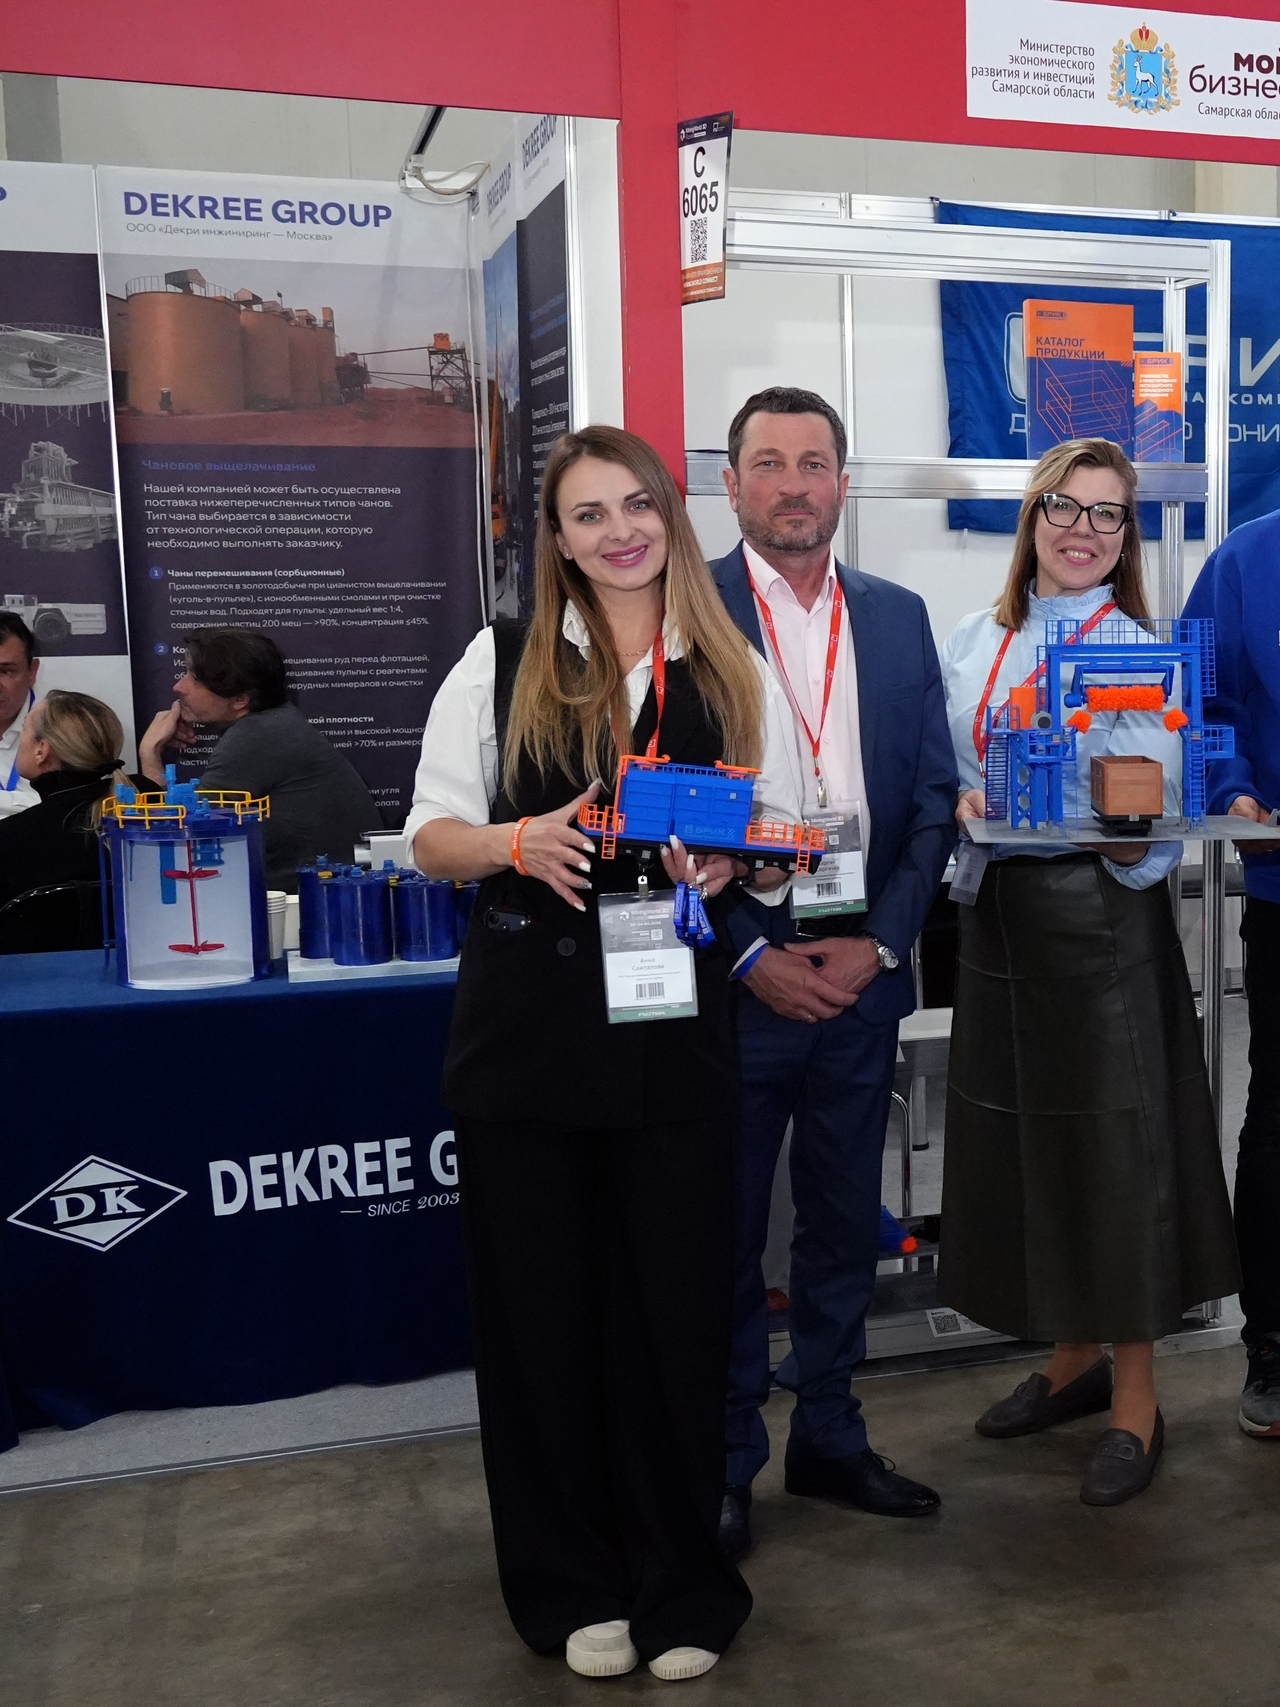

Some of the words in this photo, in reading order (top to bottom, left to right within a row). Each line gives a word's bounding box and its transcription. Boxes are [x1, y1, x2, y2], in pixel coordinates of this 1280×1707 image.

[1020, 38, 1095, 57] Министерство
[1008, 54, 1095, 71] экономического
[971, 65, 1020, 79] развития
[1023, 71, 1030, 79] и
[1033, 71, 1095, 86] инвестиций
[992, 79, 1050, 97] Самарской
[1053, 85, 1095, 99] области
[1198, 102, 1252, 119] Самарская
[682, 180, 719, 219] 6065
[123, 191, 263, 222] DEKREE
[271, 200, 392, 228] GROUP
[158, 224, 200, 237] «Декри
[202, 229, 271, 240] инжиниринг
[286, 231, 333, 242] Москва»
[1036, 336, 1085, 347] КАТАЛОГ
[1036, 348, 1105, 360] ПРОДУКЦИИ
[142, 460, 202, 471] Чановое
[206, 461, 316, 472] выщелачивание
[143, 483, 185, 493] Нашей
[186, 484, 251, 494] компанией
[253, 486, 290, 494] может
[291, 485, 319, 495] быть
[320, 486, 401, 496] осуществлена
[144, 499, 198, 507] поставка
[200, 499, 321, 509] нижеперечисленных
[323, 500, 356, 508] типов
[357, 500, 393, 508] чанов.
[145, 511, 167, 521] Тип
[169, 512, 197, 521] чана
[199, 511, 267, 523] выбирается
[269, 513, 277, 521] в
[278, 512, 351, 521] зависимости
[146, 526, 160, 535] от
[161, 525, 263, 535] технологической
[265, 526, 324, 536] операции,
[325, 526, 373, 537] которую
[147, 538, 220, 549] необходимо
[222, 539, 284, 549] выполнять
[285, 539, 343, 550] заказчику.
[153, 569, 160, 577] 1
[167, 569, 194, 578] Чаны
[195, 569, 273, 579] перемешивания
[274, 568, 345, 578] (сорбционные)
[168, 582, 234, 591] Применяются
[242, 582, 307, 590] золотодобыче
[327, 582, 375, 590] цианистом
[376, 581, 447, 589] выщелачивании
[264, 594, 340, 602] ионообменными
[341, 594, 380, 602] смолами
[389, 594, 406, 602] при
[407, 593, 442, 601] очистке
[230, 607, 274, 616] Подходят
[292, 607, 327, 615] пульпы:
[328, 606, 371, 615] удельный
[170, 621, 228, 630] содержание
[262, 619, 280, 627] 200
[341, 619, 405, 627] концентрация
[158, 645, 165, 653] 2
[334, 656, 350, 664] руд
[380, 654, 430, 663] флотацией,
[336, 668, 368, 677] пульпы
[376, 668, 430, 676] реагентами.
[331, 680, 381, 688] минералов
[326, 716, 374, 724] плотности
[355, 727, 391, 735] высокой
[385, 740, 422, 748] размеро
[381, 788, 400, 796] угля
[208, 1136, 415, 1217] DEKREE
[50, 1185, 145, 1224] DK
[367, 1199, 411, 1218] SINCE
[416, 1192, 460, 1210] 2003
